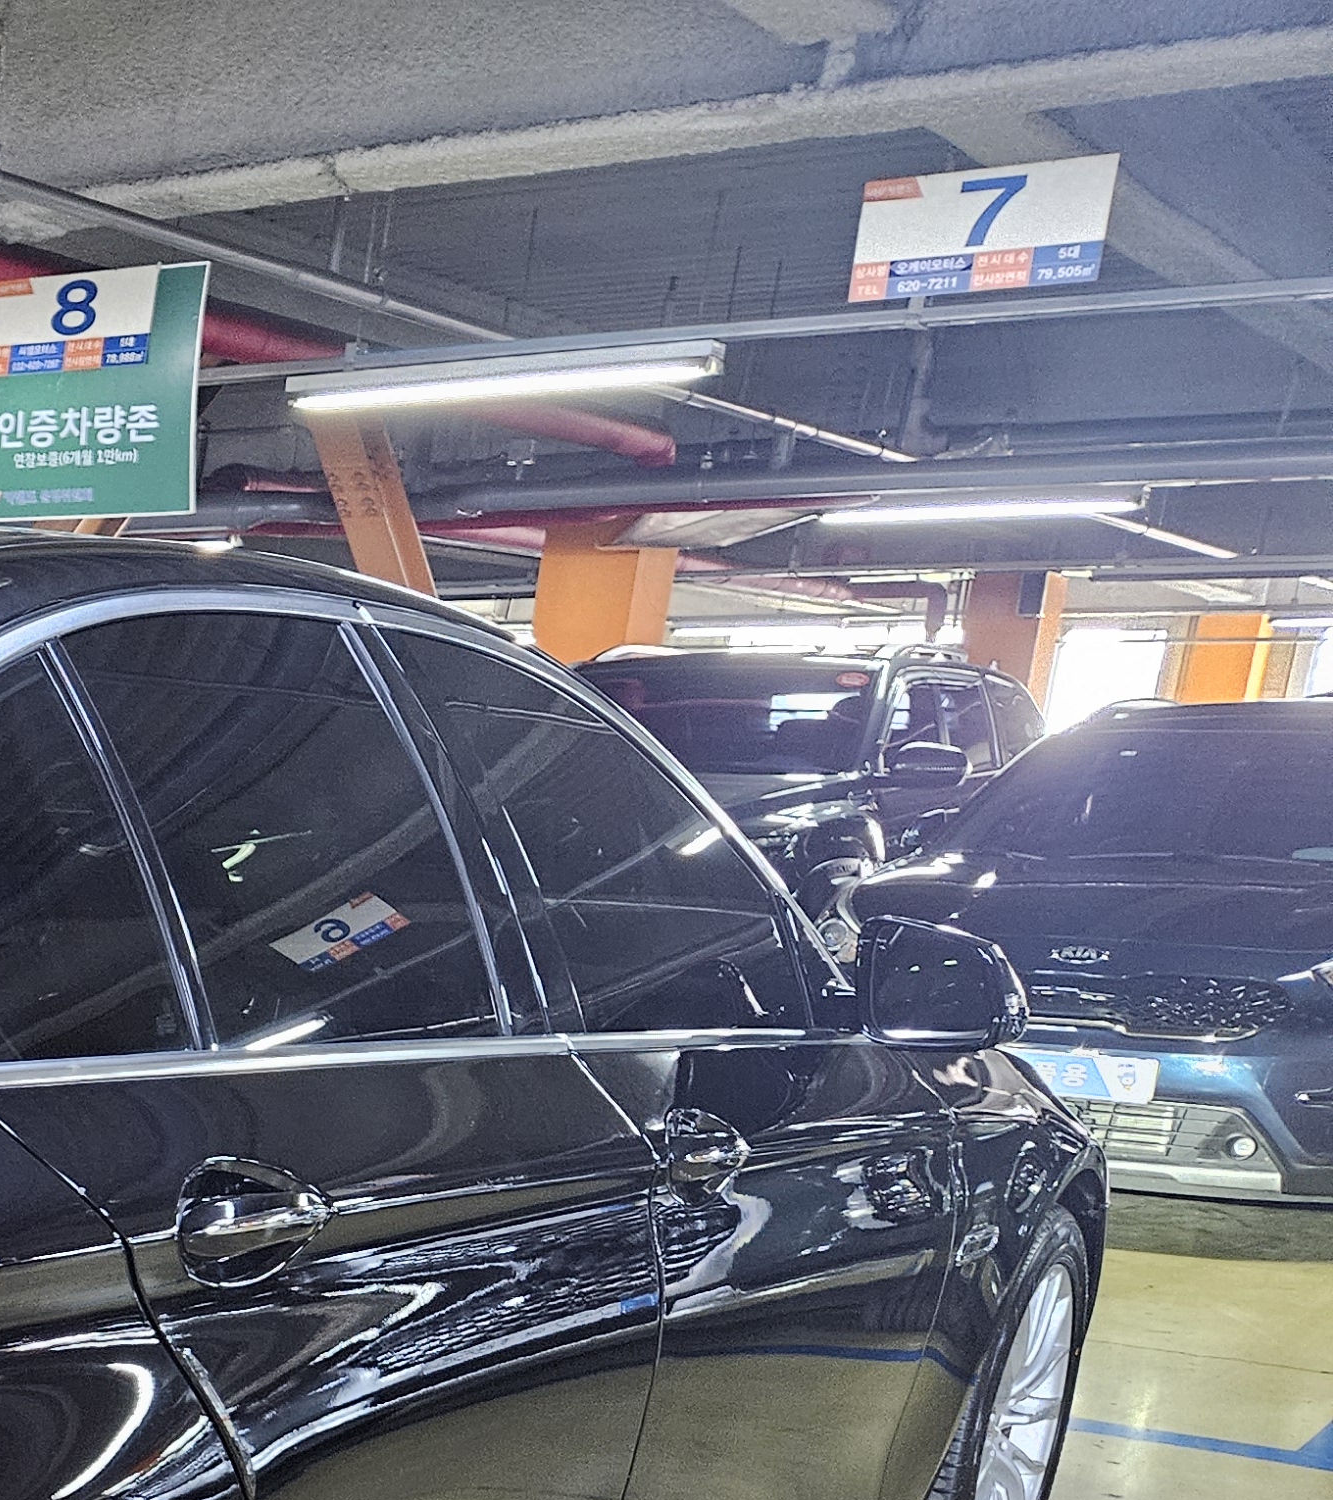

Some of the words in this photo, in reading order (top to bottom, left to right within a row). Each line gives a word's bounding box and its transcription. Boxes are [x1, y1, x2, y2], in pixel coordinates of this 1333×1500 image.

[960, 174, 1028, 247] 7
[1058, 245, 1081, 259] 5대
[897, 257, 967, 276] 오케이모터스
[857, 285, 879, 296] TEL
[897, 276, 958, 293] 620-7211
[50, 279, 99, 336] 8
[1060, 946, 1098, 960] KIA
